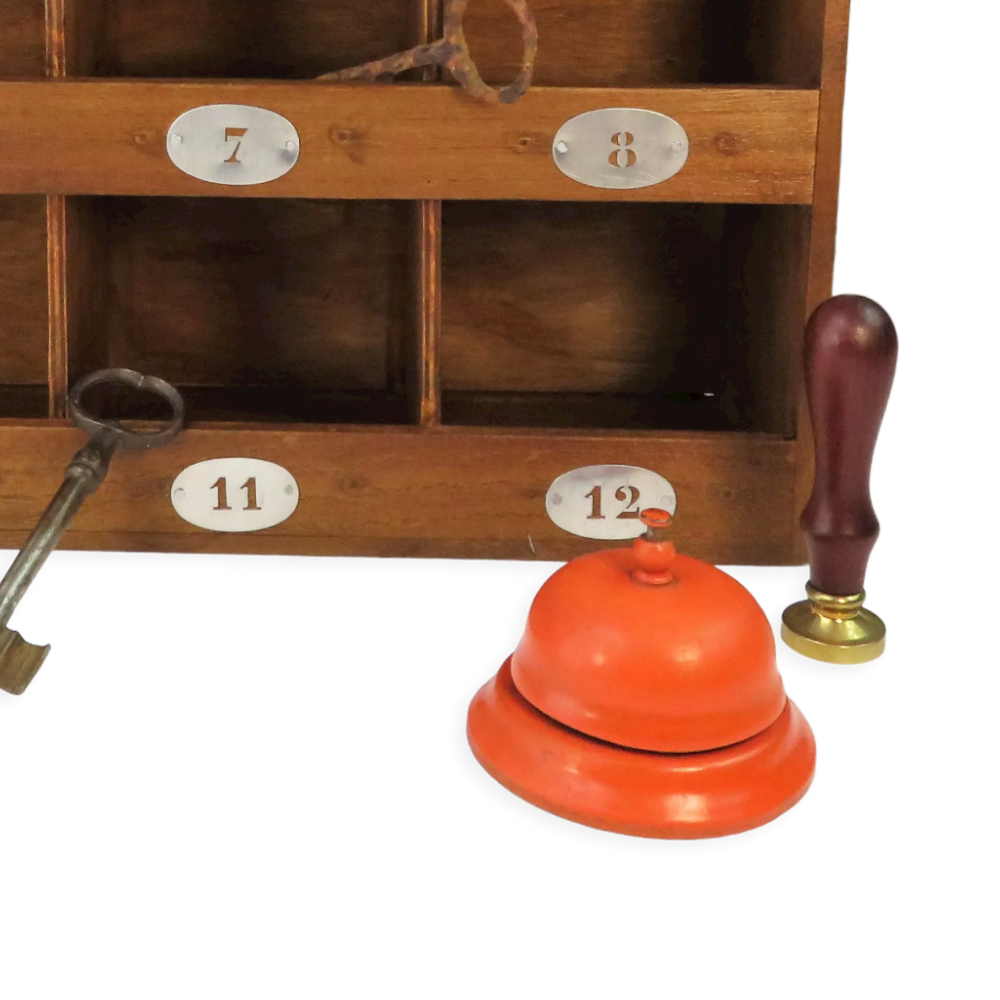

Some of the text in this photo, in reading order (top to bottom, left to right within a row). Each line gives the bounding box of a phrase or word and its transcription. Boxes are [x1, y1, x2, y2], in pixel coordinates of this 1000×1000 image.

[223, 127, 248, 163] 7
[608, 131, 638, 168] 8
[209, 476, 262, 511] 11
[584, 485, 641, 520] 12
